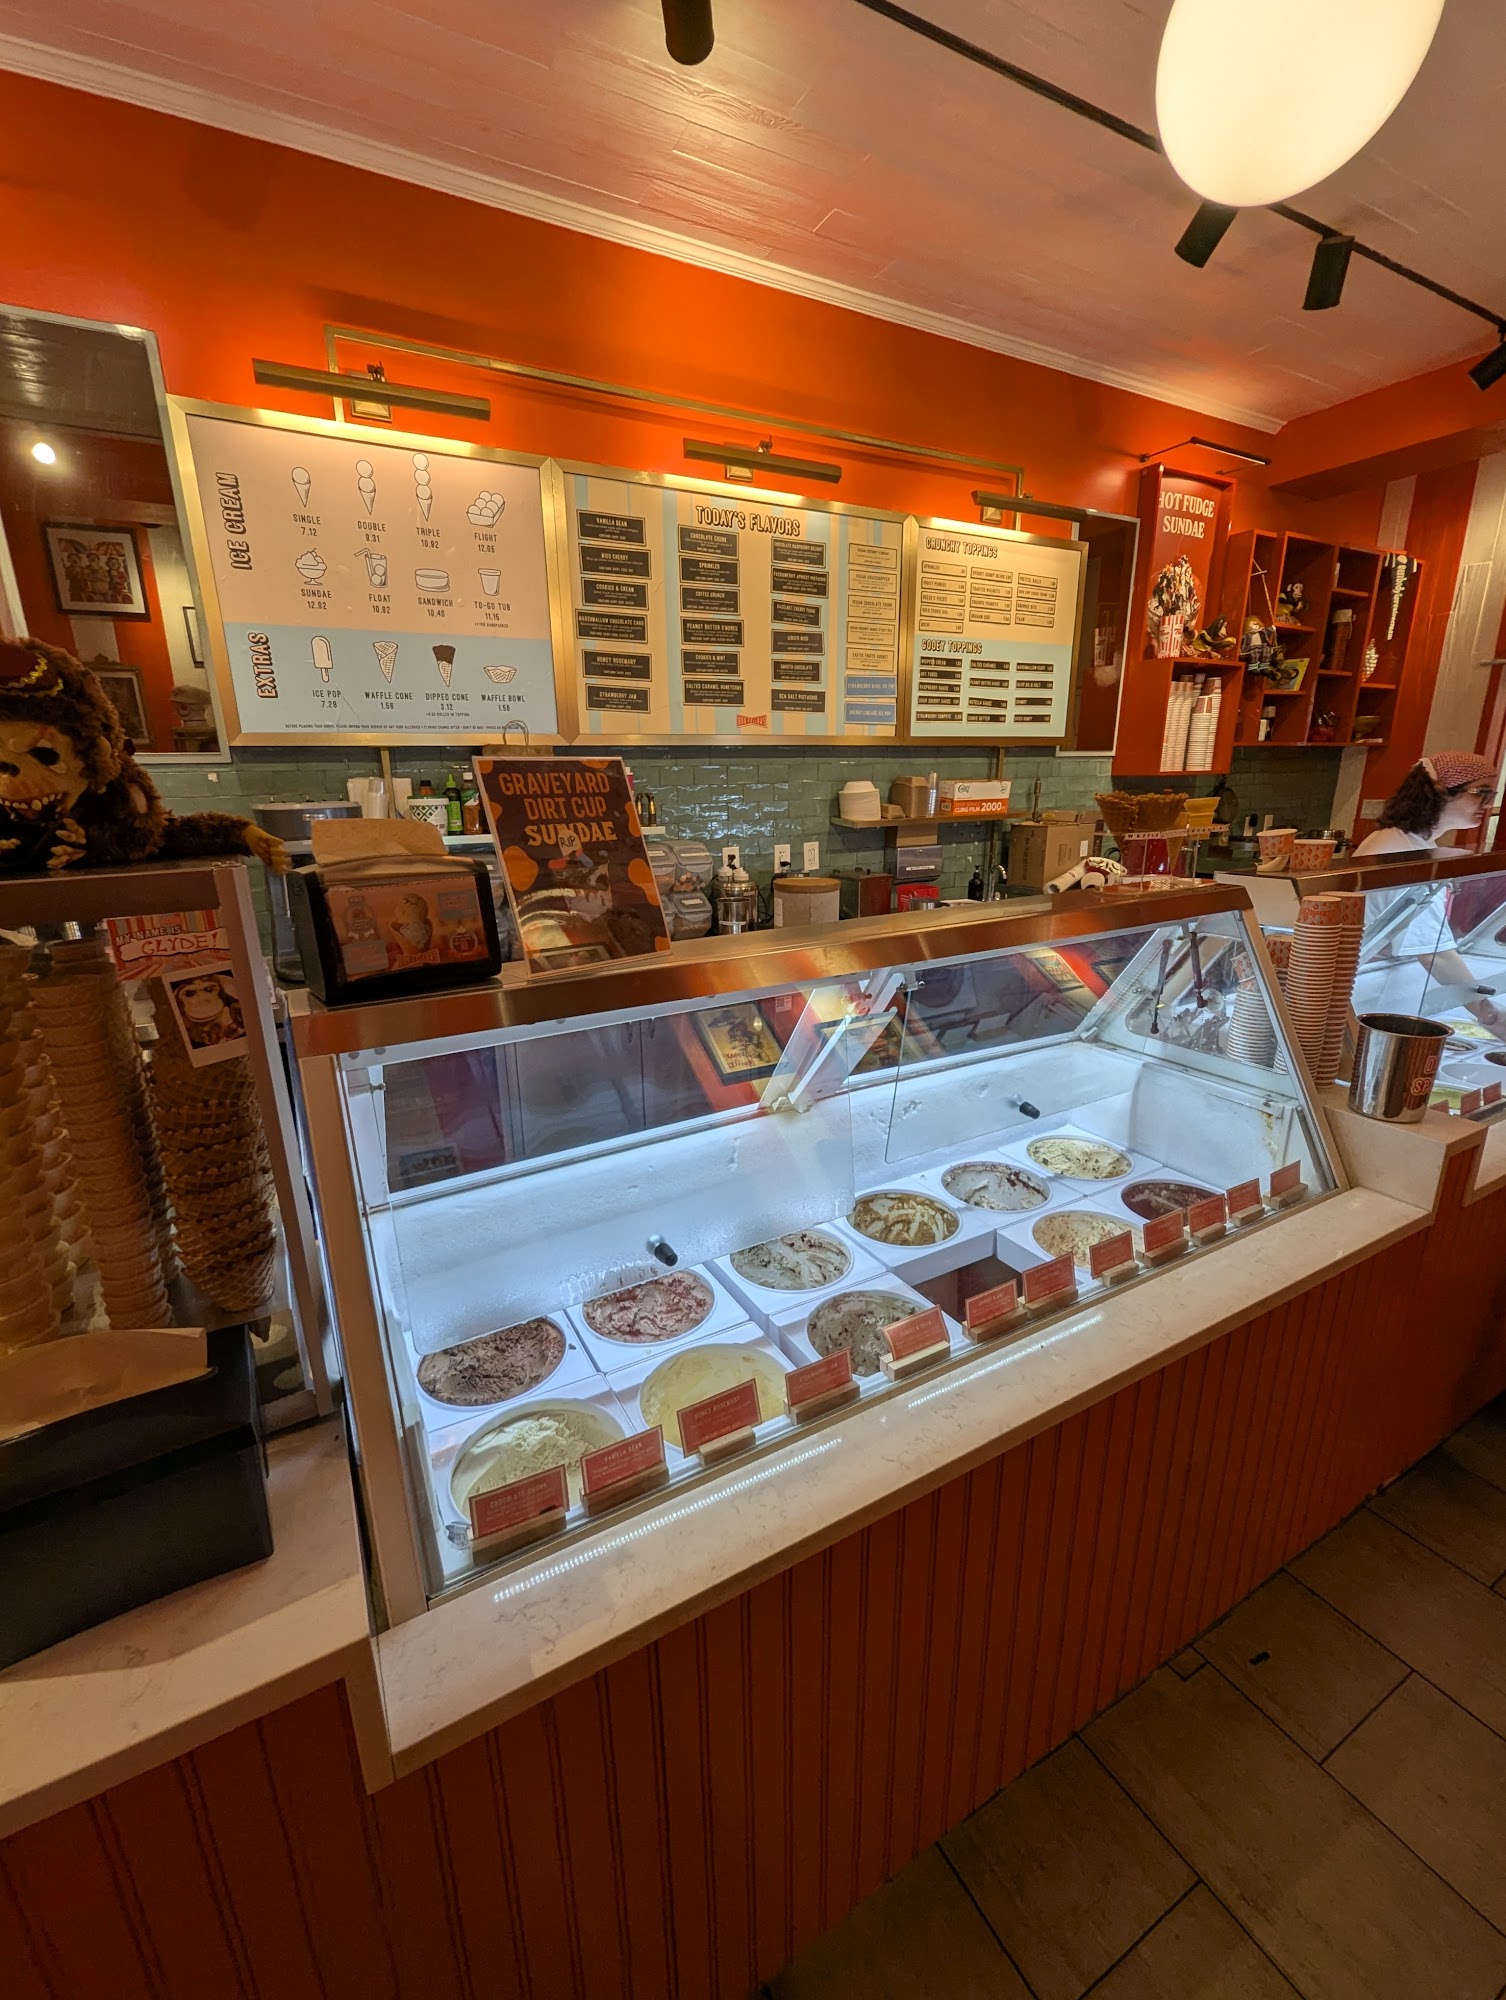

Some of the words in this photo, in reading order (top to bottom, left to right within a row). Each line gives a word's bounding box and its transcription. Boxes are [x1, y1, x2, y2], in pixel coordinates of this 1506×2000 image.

[216, 472, 246, 534] CREAM
[1158, 491, 1182, 511] HOT
[1182, 494, 1215, 518] FUDGE
[293, 514, 321, 525] SINGLE
[696, 505, 745, 529] TODAY'S
[750, 513, 800, 536] FLAVORS
[301, 527, 317, 536] 7.12
[357, 521, 386, 532] DOUBLE
[416, 527, 440, 537] TRIPLE
[1162, 515, 1205, 539] SUNDAE
[474, 533, 497, 542] FLIGHT
[926, 536, 961, 554] CRUNCHY
[963, 542, 998, 558] TOPPINGS
[227, 540, 252, 570] ICE
[301, 589, 332, 598] SUNDAE
[368, 594, 391, 603] FLOAT
[418, 597, 453, 607] SANDWICH
[474, 601, 495, 610] TO-GO
[498, 603, 511, 611] TUB
[921, 639, 946, 652] GOOEY
[947, 640, 983, 654] TOPPINGS
[248, 632, 278, 698] EXTRAS
[312, 690, 325, 698] ICE
[365, 691, 393, 700] WAFFLE
[395, 692, 413, 700] CONE
[425, 693, 449, 701] DIPPED
[481, 694, 506, 702] WAFFLE
[498, 770, 610, 796] GRAVEYARD
[524, 797, 567, 821] DIRT
[571, 796, 607, 818] CUP
[981, 802, 1002, 812] 2000
[524, 821, 618, 847] SUNDAE
[116, 933, 131, 946] MY
[137, 927, 167, 941] NAME
[171, 926, 181, 934] IS
